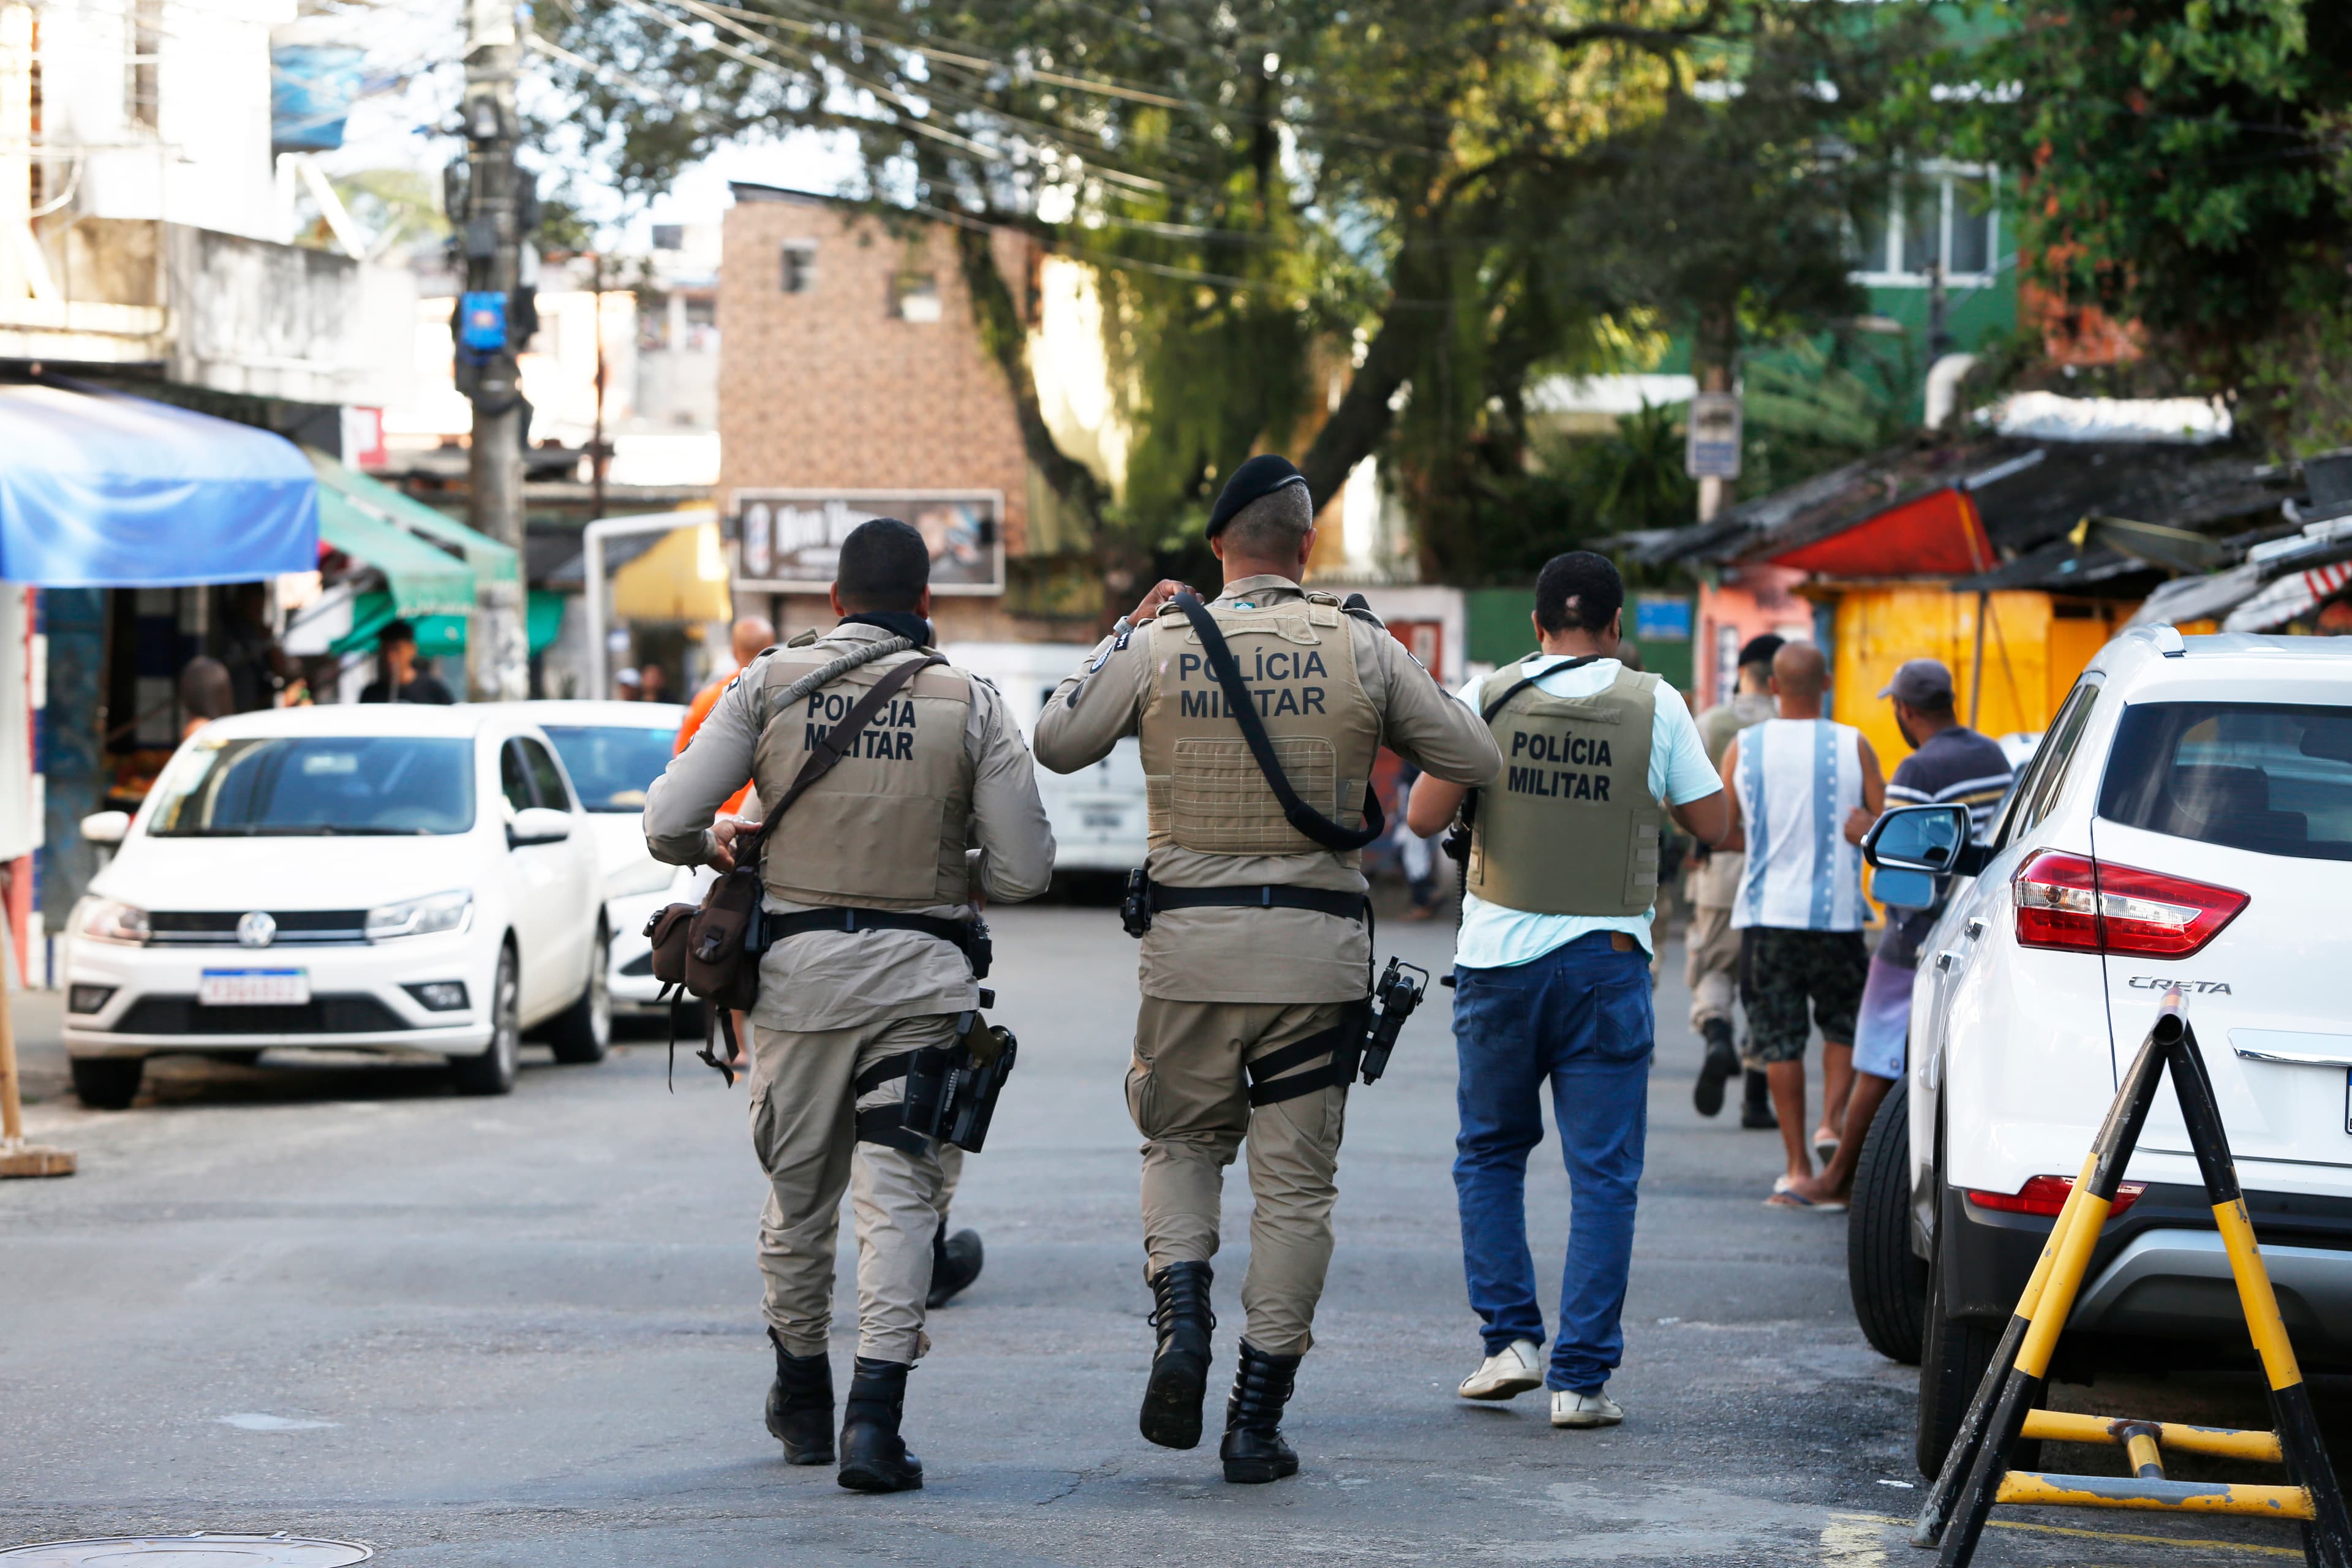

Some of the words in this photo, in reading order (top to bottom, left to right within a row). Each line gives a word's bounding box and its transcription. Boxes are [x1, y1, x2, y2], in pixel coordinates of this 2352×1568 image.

[807, 691, 916, 728] POCIA
[1181, 687, 1326, 718] MILTAR
[804, 723, 913, 760] MITAR
[1511, 731, 1612, 766] POLÍCIA
[1508, 766, 1610, 801] MILITAR
[2128, 974, 2232, 995] CRETA
